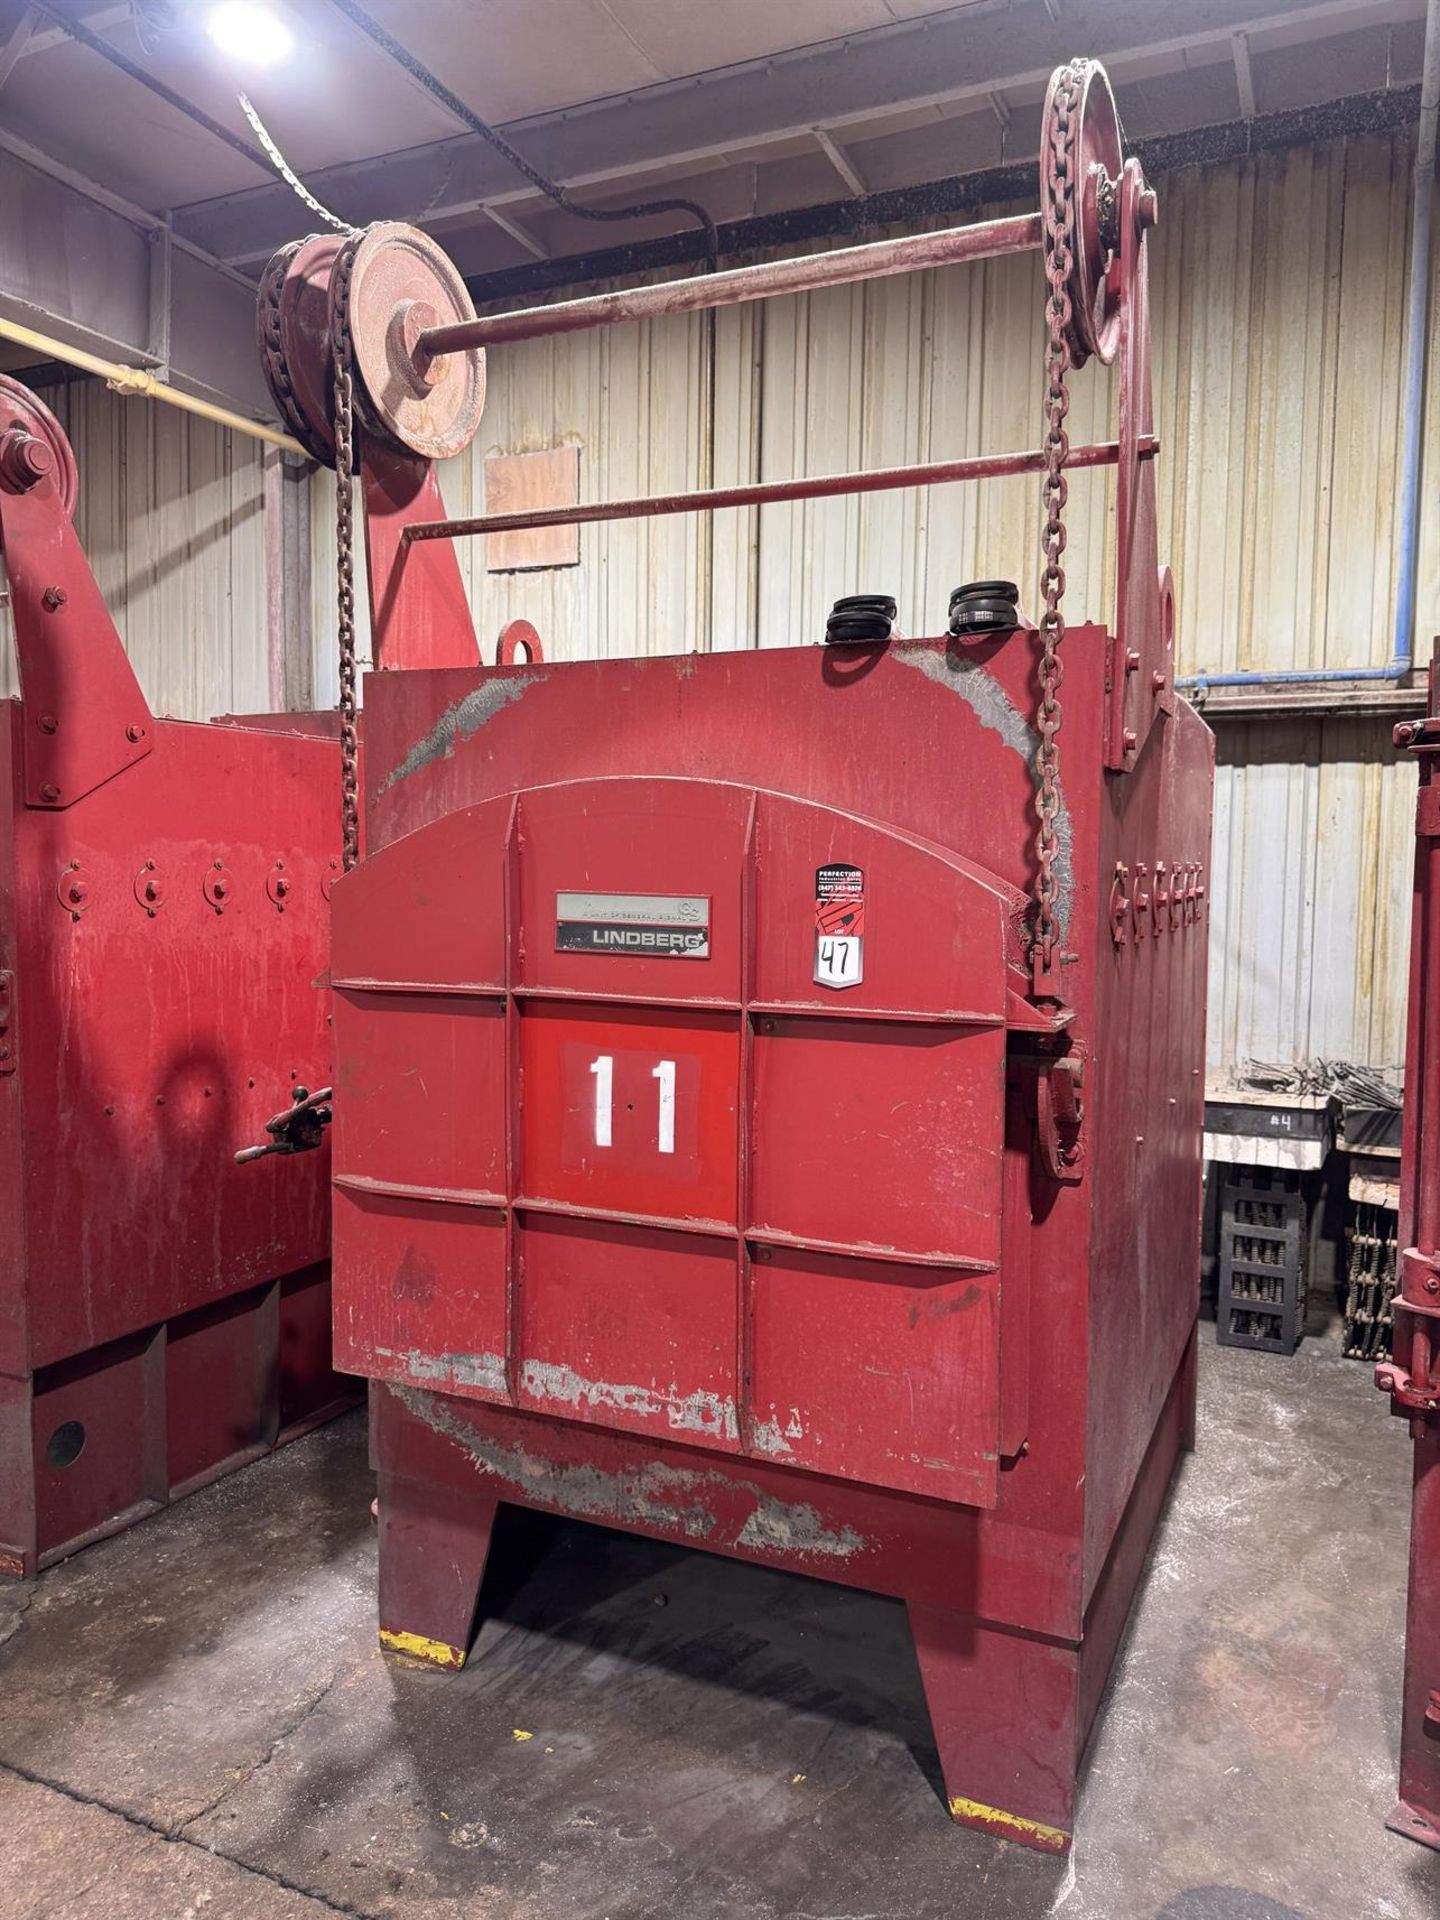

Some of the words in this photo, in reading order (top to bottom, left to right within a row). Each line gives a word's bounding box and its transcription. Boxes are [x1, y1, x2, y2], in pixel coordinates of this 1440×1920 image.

[593, 930, 701, 948] LINDBERG
[821, 941, 849, 974] 47
[590, 1055, 676, 1153] 11
[1270, 1115, 1291, 1131] #4
